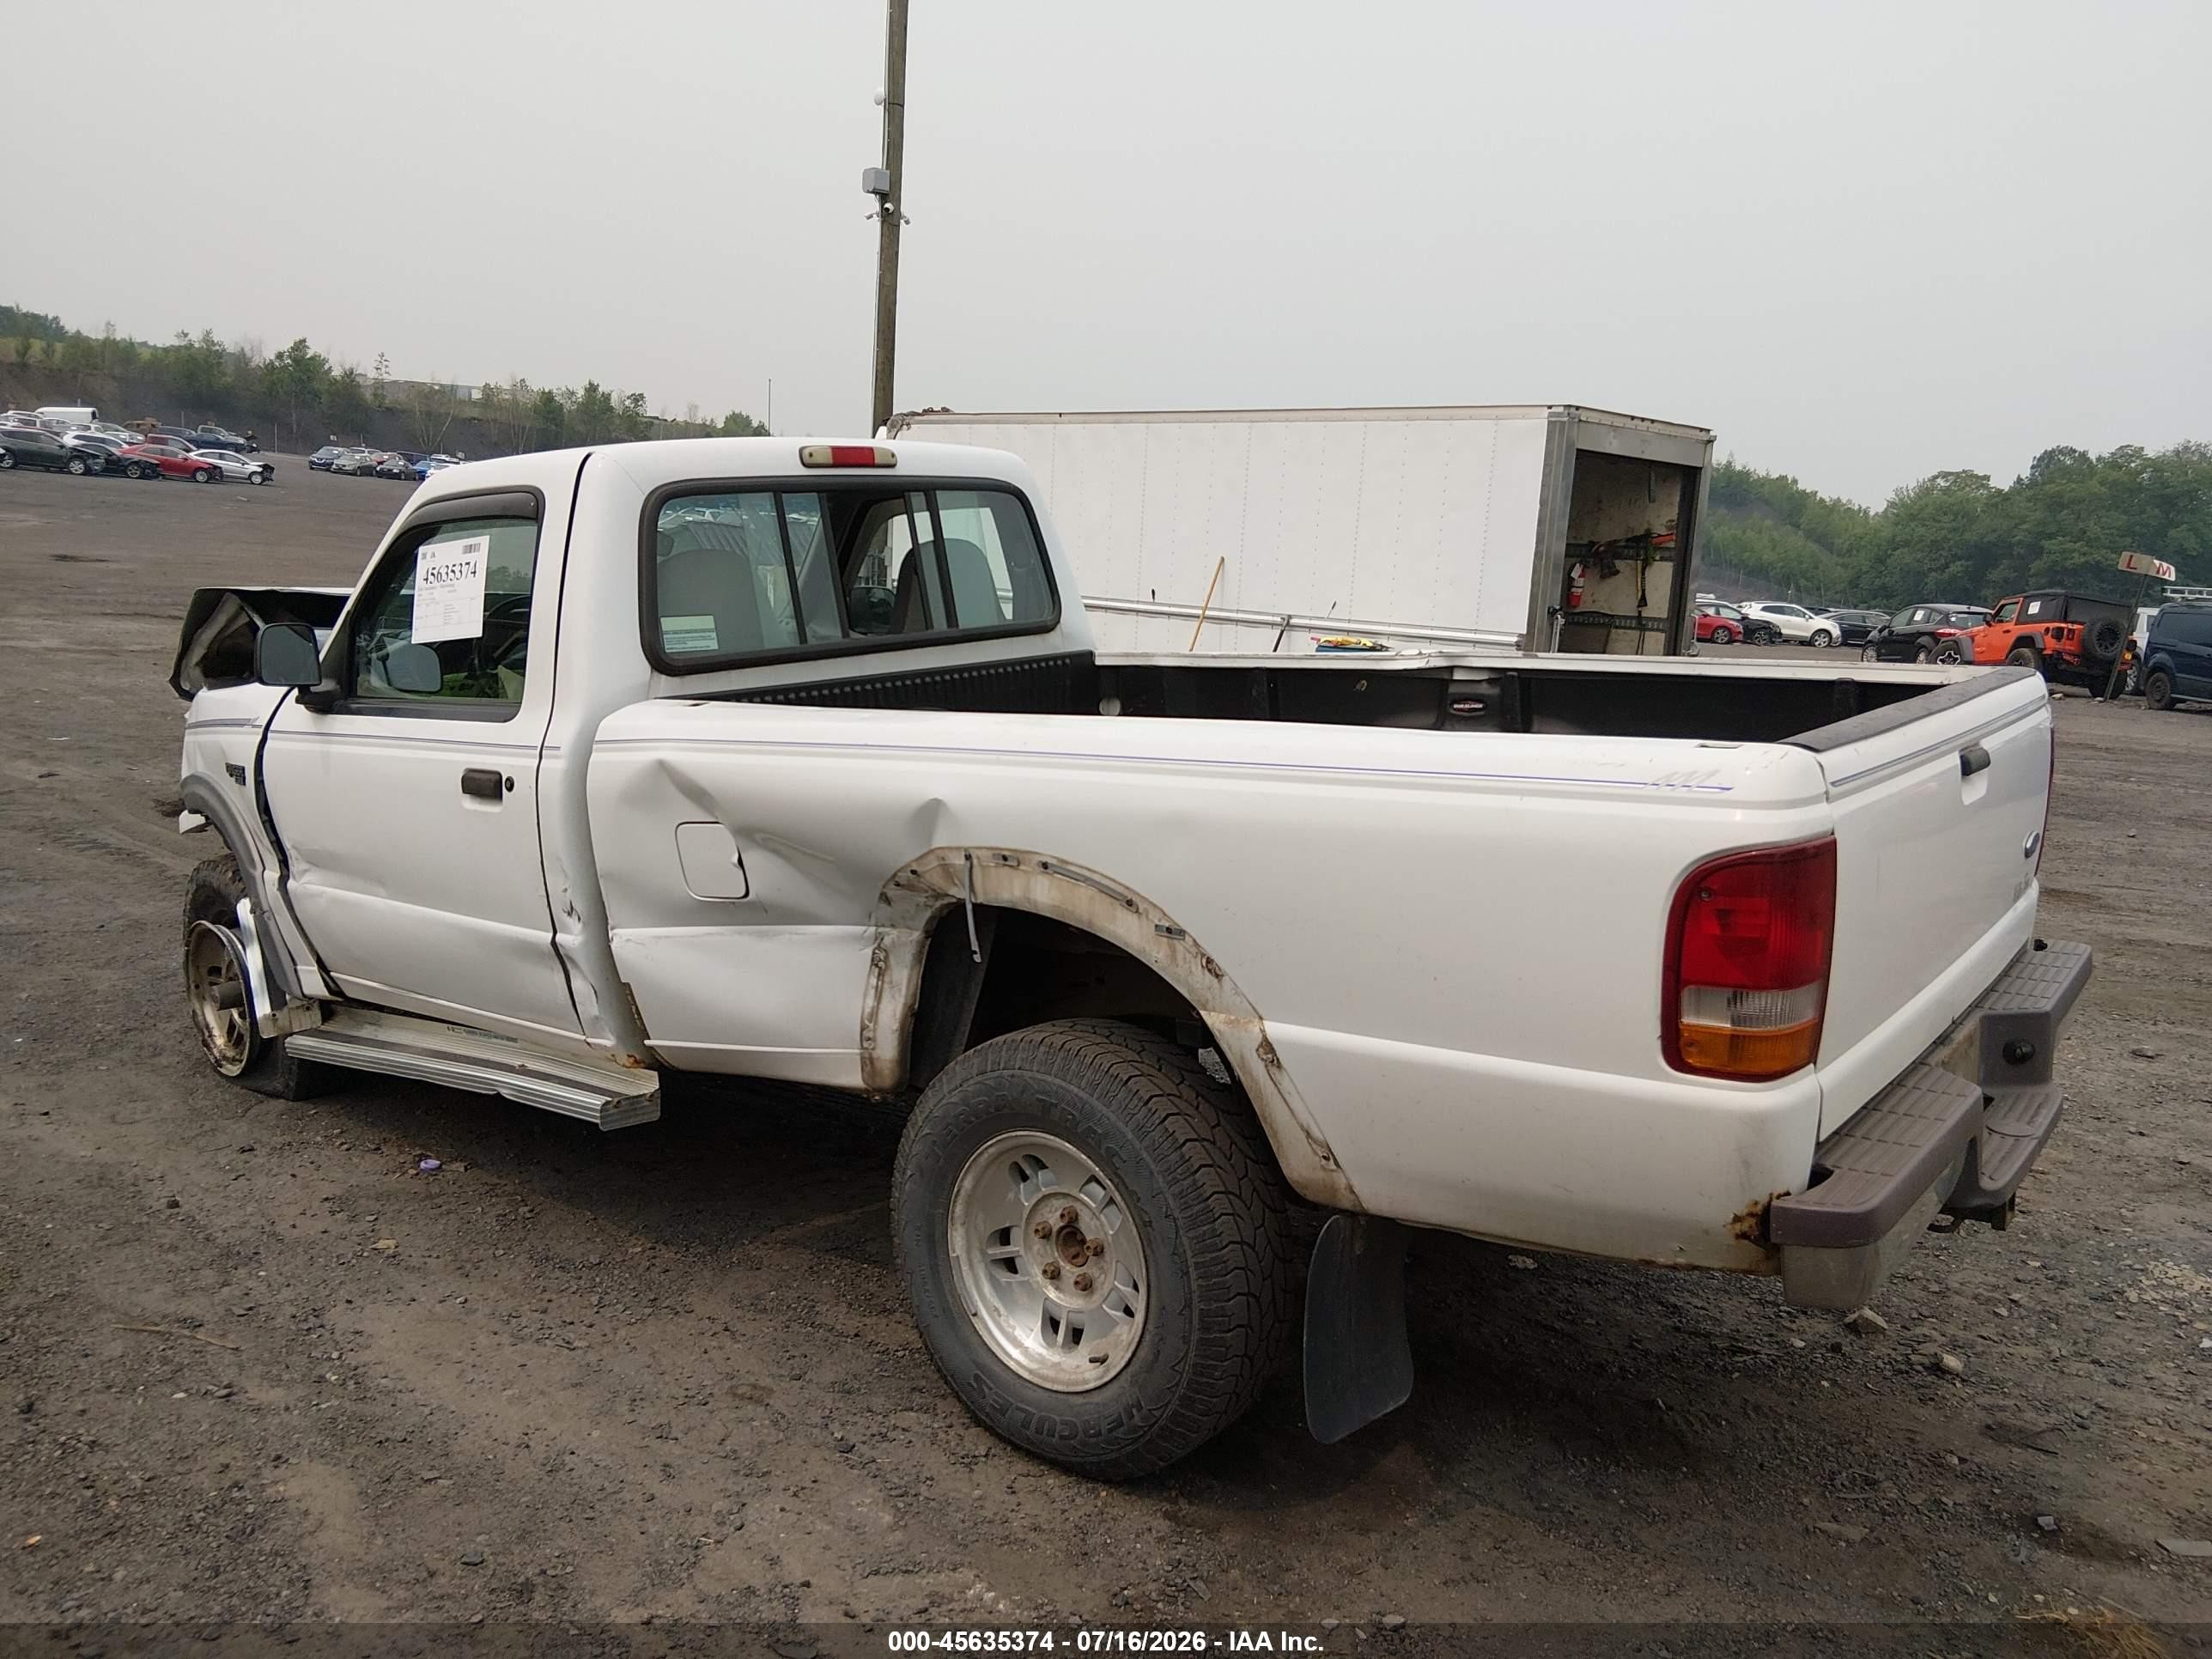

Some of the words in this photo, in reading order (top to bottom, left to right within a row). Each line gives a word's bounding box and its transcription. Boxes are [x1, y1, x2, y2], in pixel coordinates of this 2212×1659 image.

[423, 560, 477, 584] 45635374
[2125, 554, 2137, 570] L
[2156, 562, 2172, 579] M
[963, 1371, 1146, 1441] HERCULES
